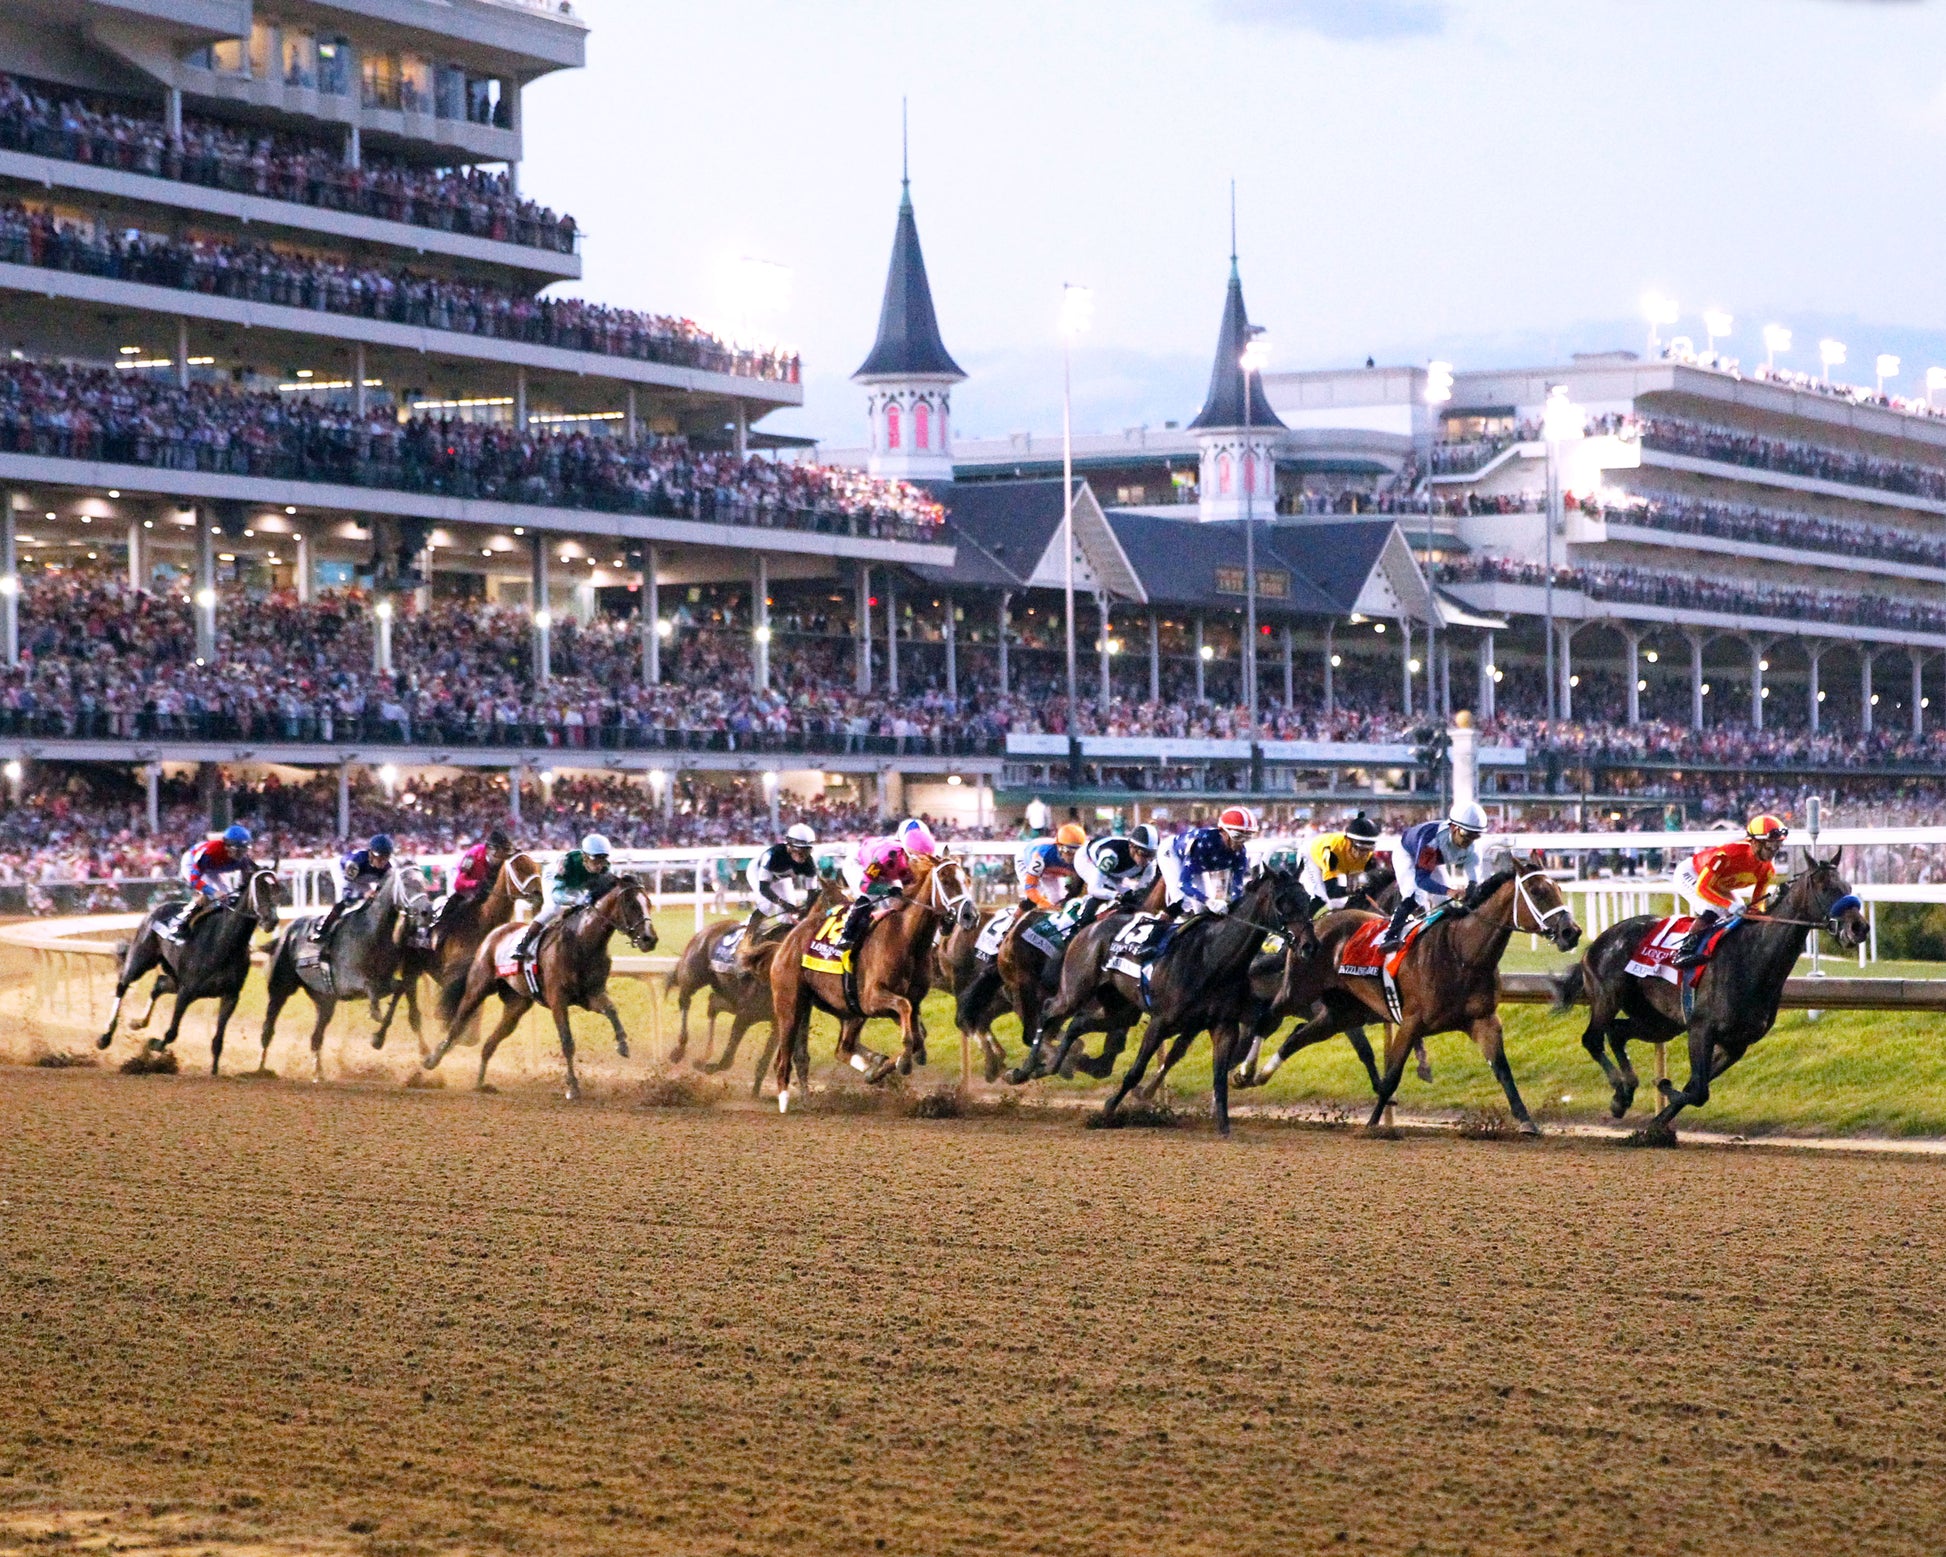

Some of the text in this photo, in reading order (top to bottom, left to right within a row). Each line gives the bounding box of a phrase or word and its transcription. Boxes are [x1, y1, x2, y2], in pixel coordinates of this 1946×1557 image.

[1032, 861, 1041, 873] 2
[816, 905, 850, 946] 14
[987, 908, 1015, 936] 2
